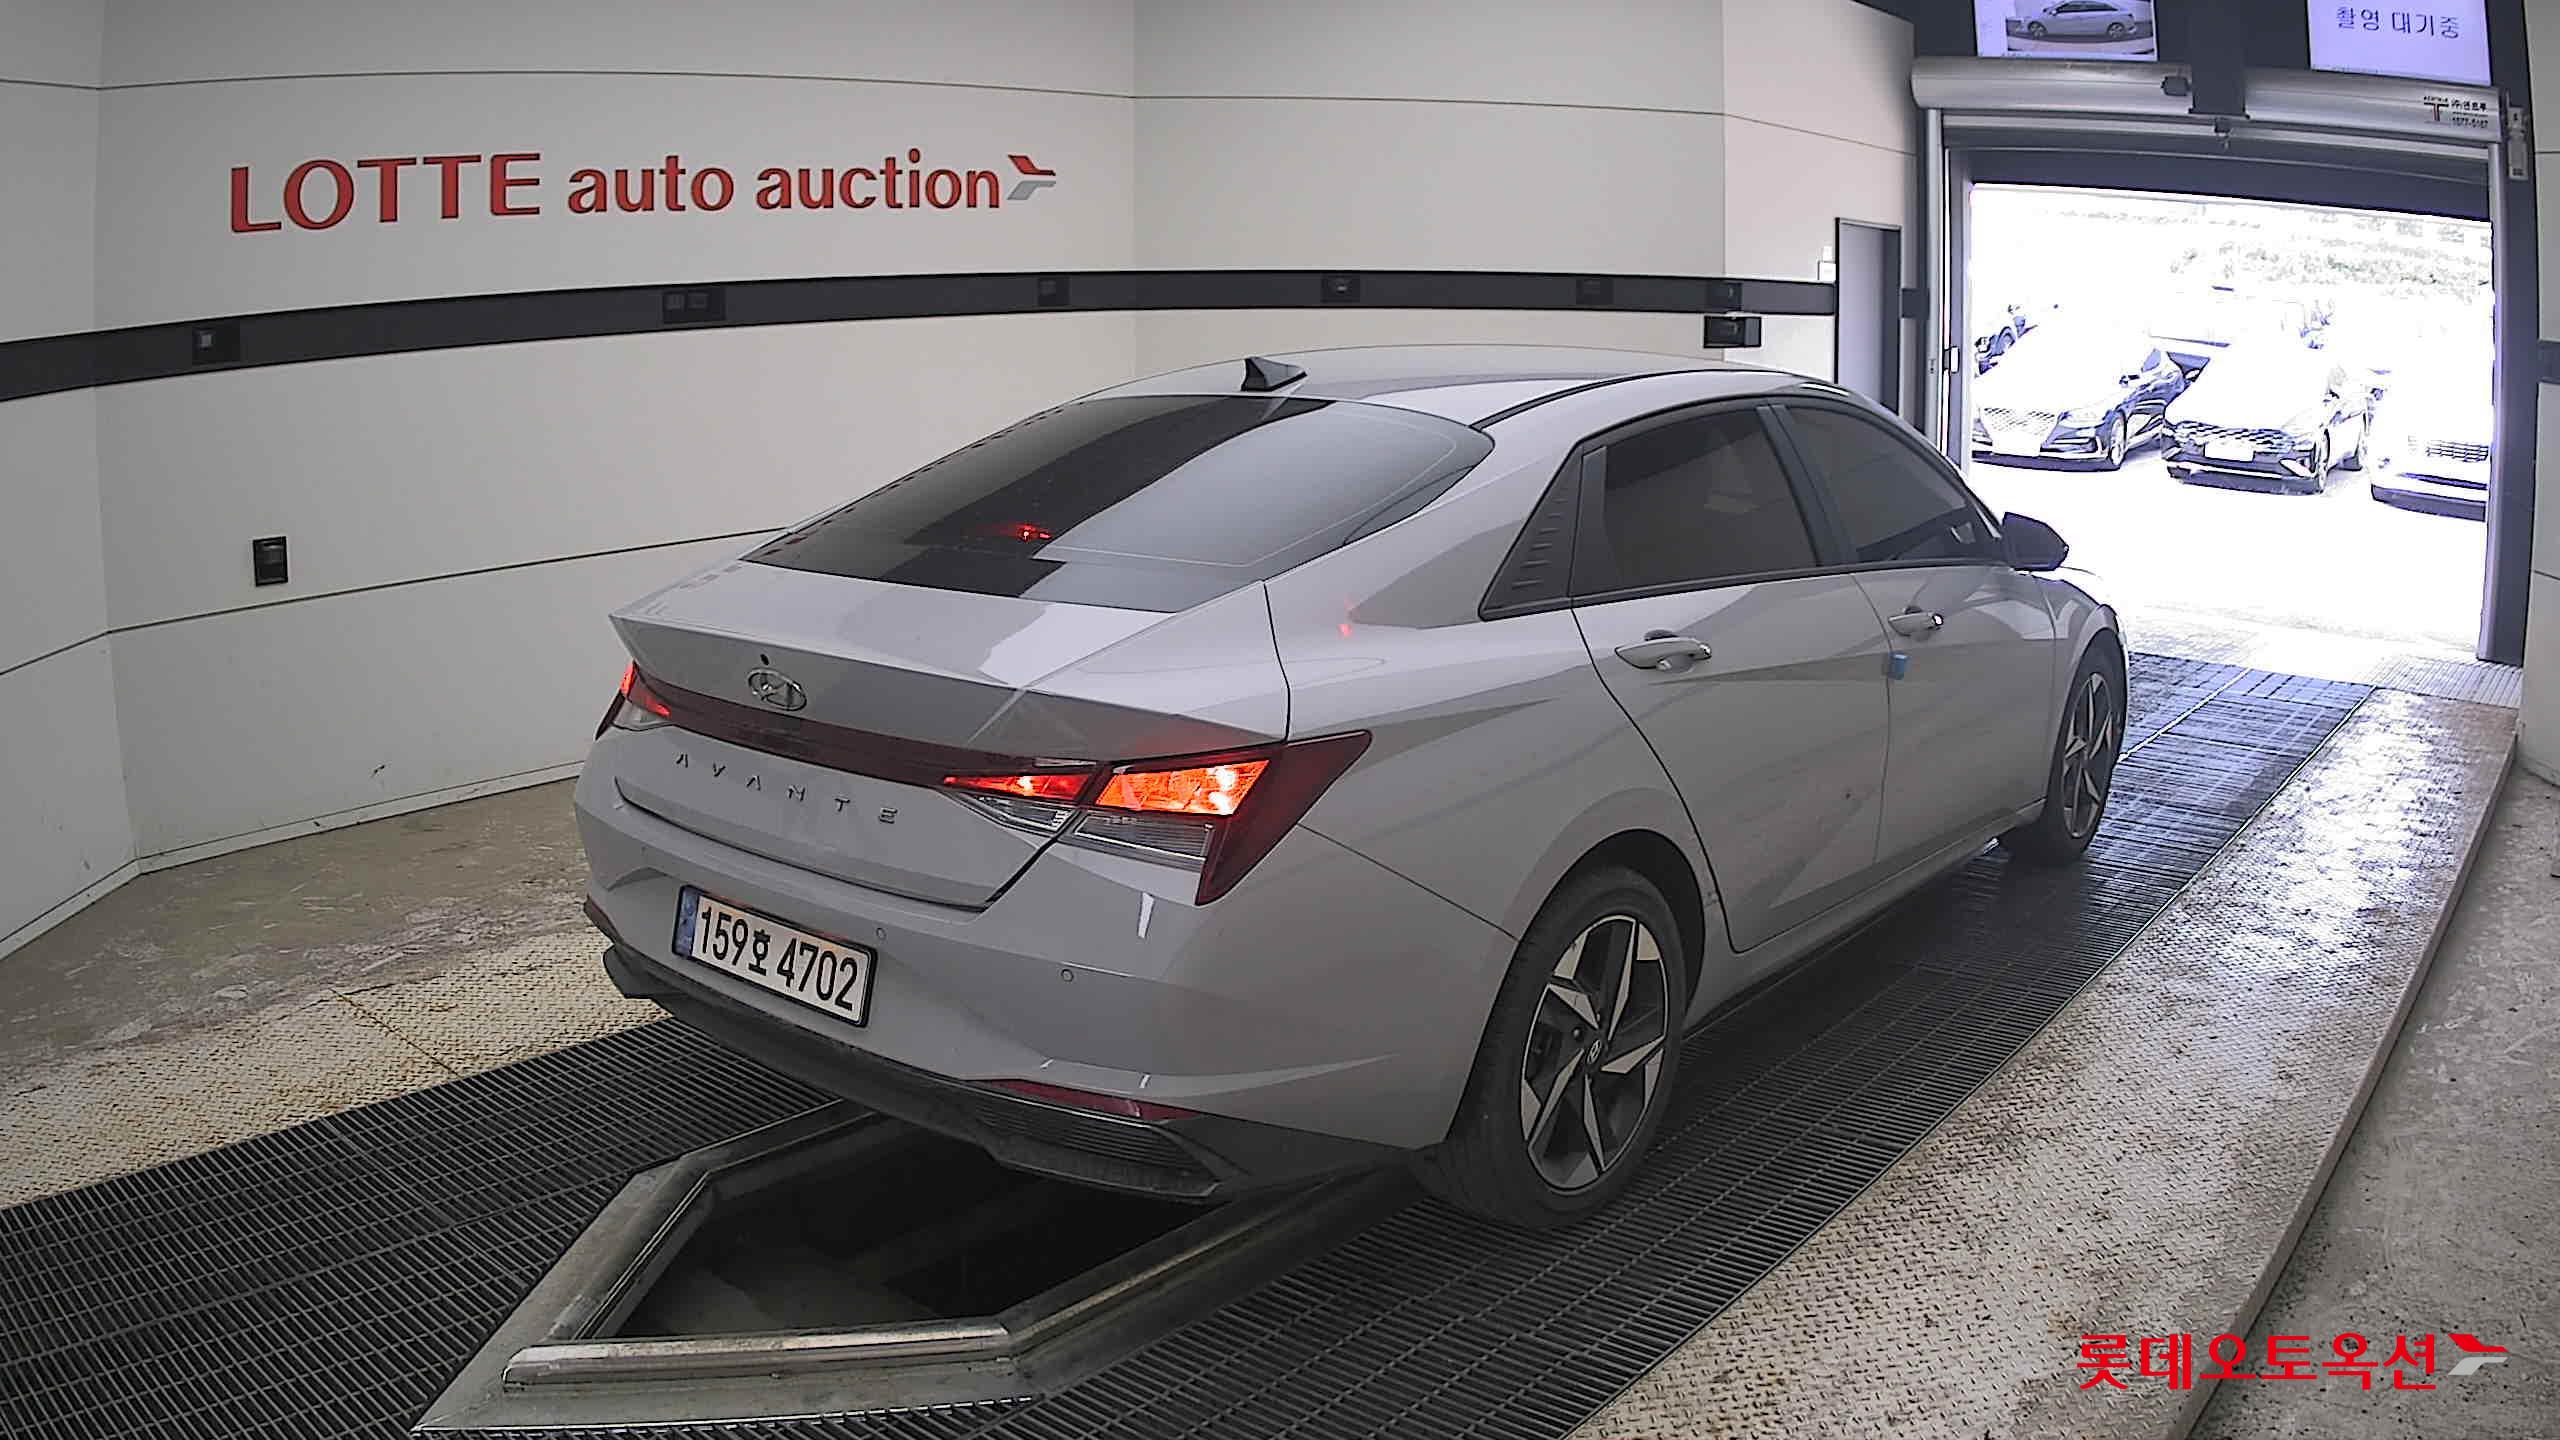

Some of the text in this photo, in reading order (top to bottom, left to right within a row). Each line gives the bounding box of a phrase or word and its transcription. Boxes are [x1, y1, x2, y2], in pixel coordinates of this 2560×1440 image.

[2337, 6, 2460, 40] 촬영 대기중
[230, 147, 1001, 233] LOTTE auto auction
[676, 753, 899, 825] AVANTE
[700, 906, 858, 1012] 159호 4702
